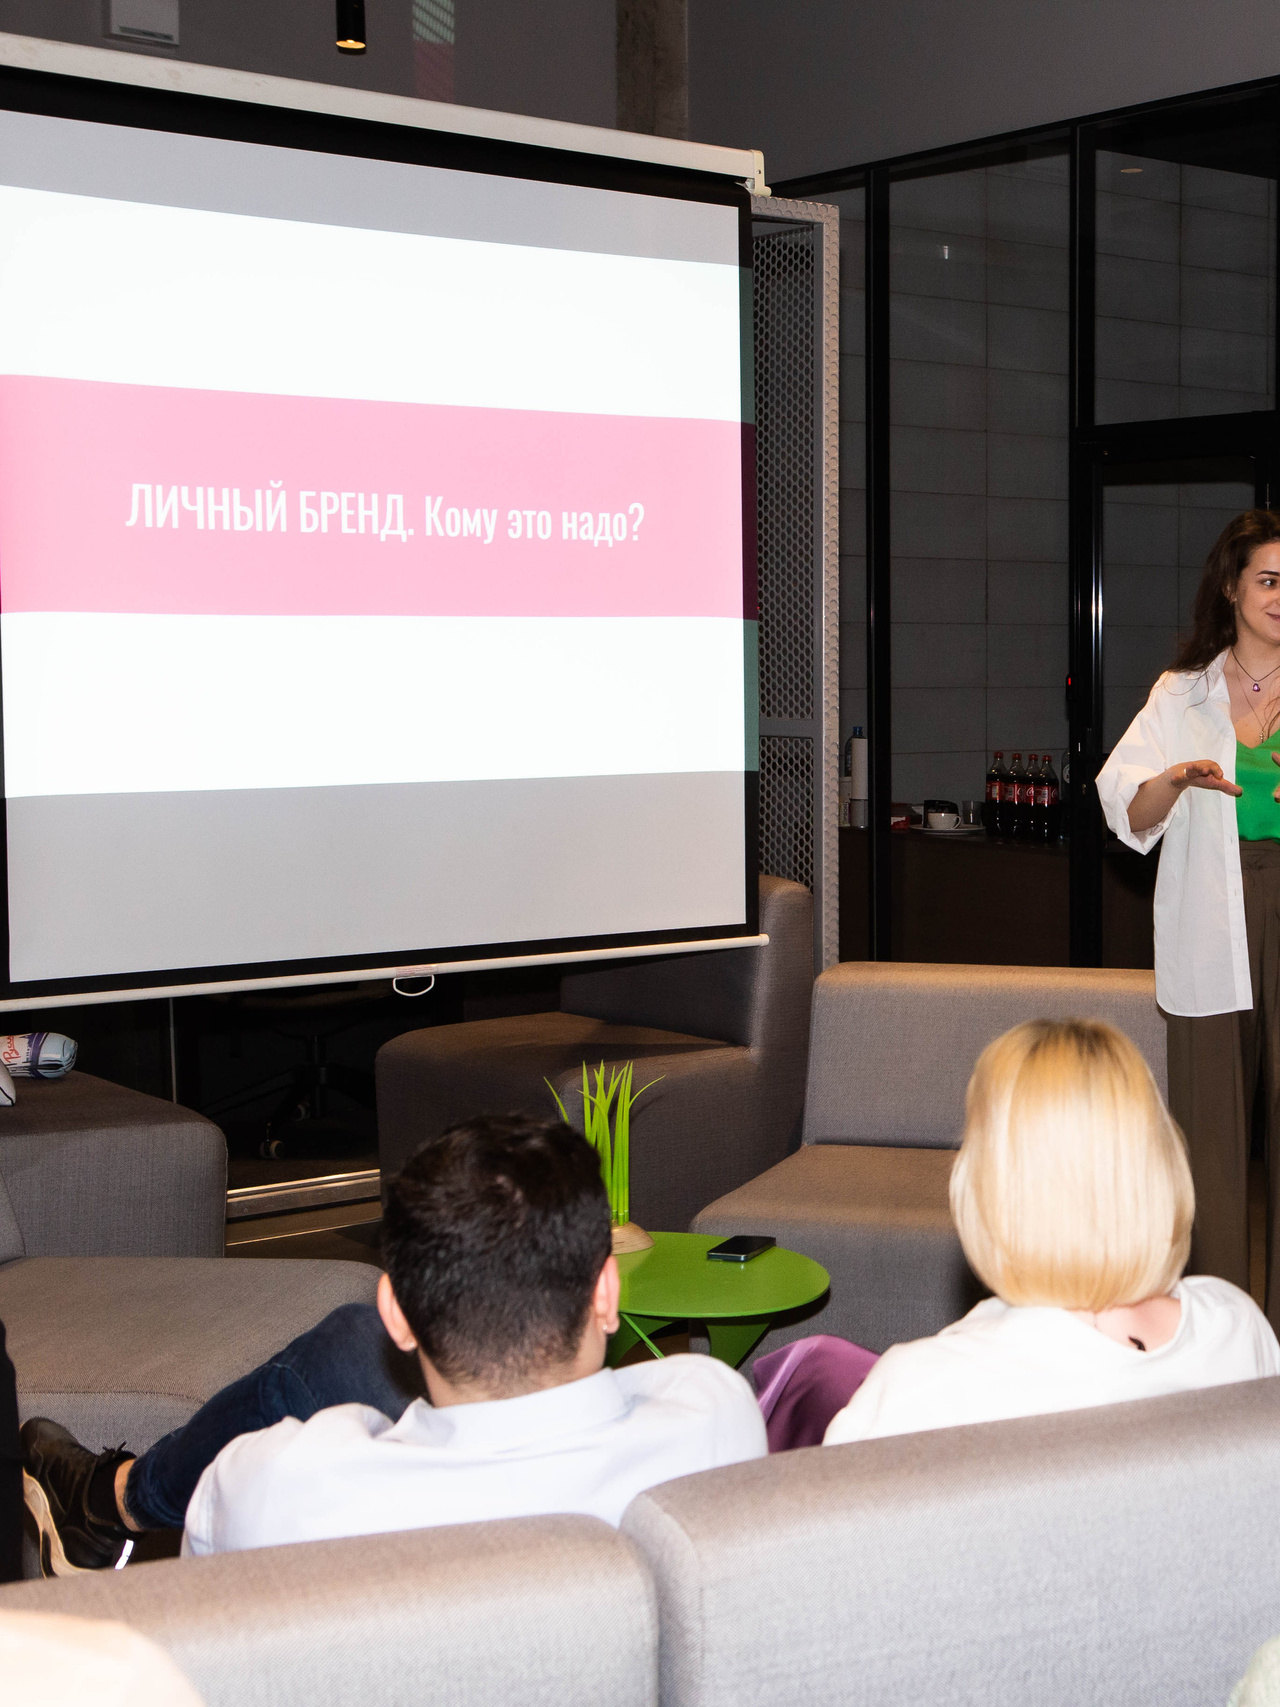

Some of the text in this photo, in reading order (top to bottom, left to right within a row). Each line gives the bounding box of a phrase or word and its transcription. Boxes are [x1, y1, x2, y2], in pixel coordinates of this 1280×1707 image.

[125, 479, 645, 547] ЛИЧНЫЙ БРЕНД. Кому это надо?
